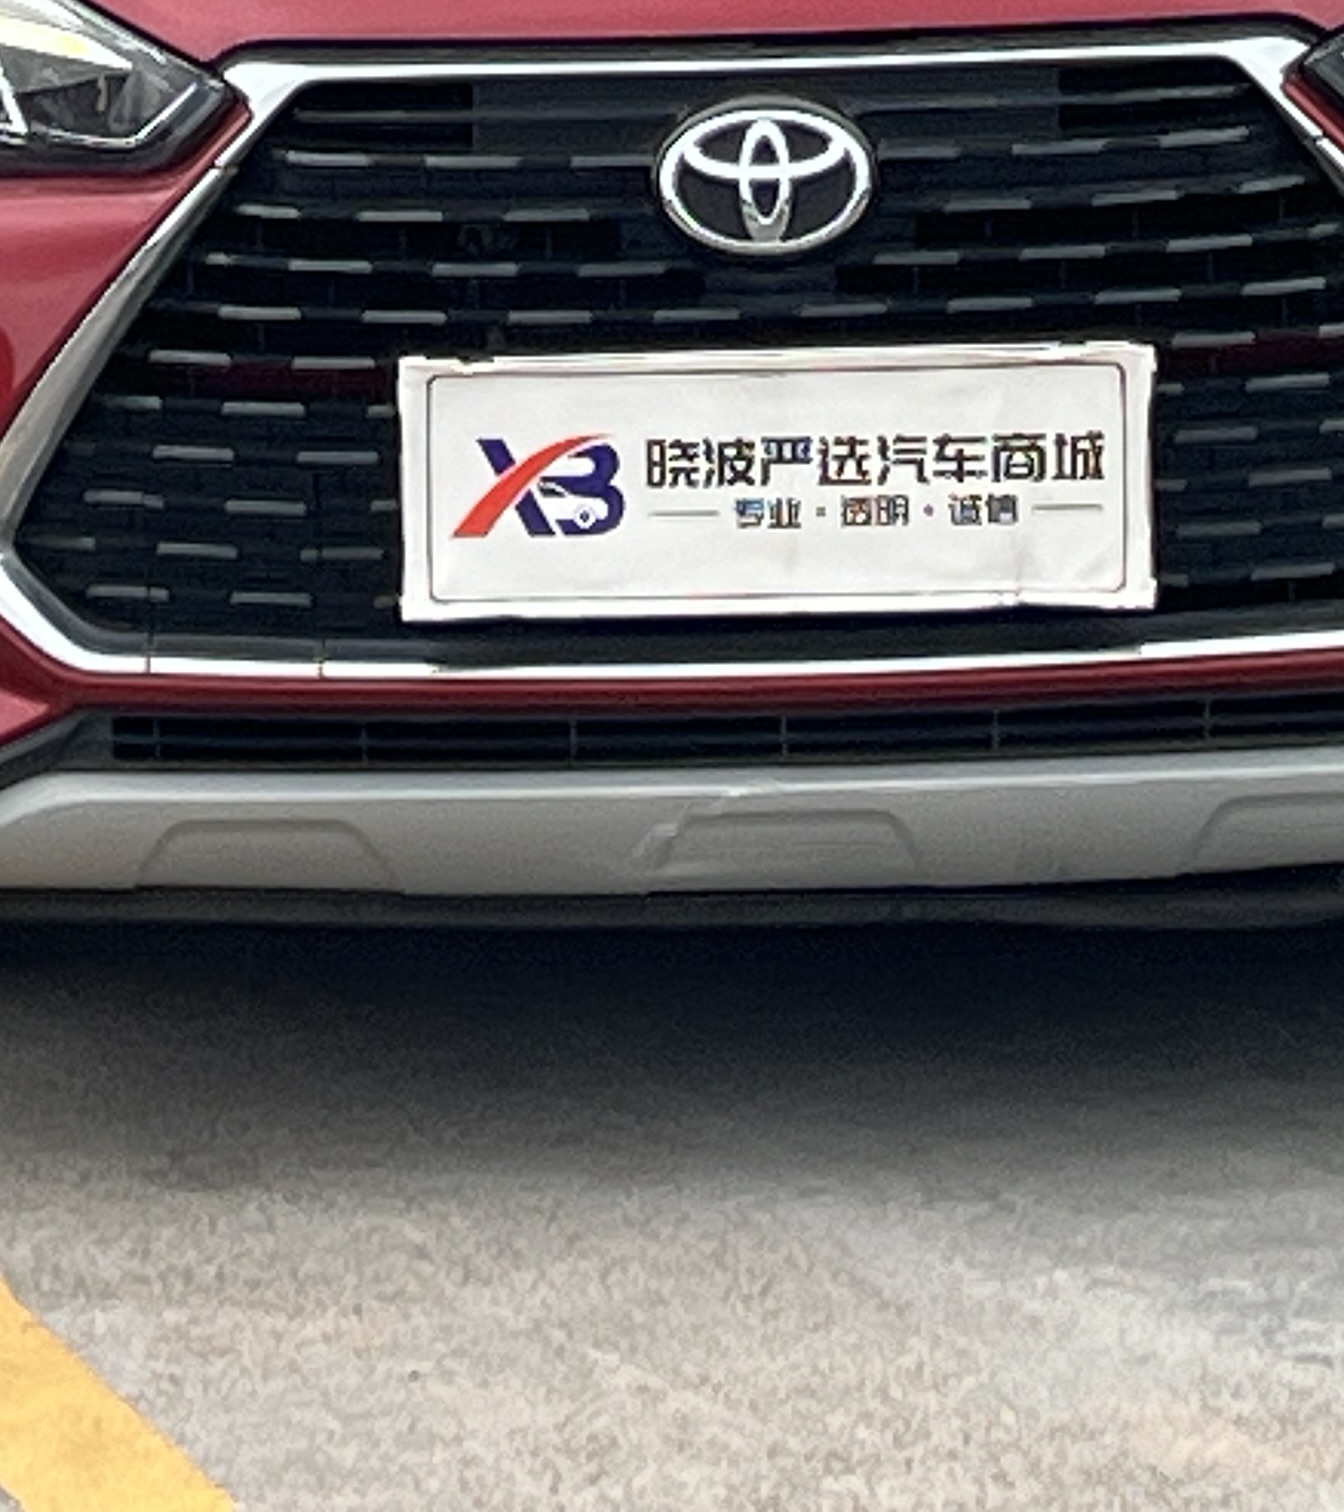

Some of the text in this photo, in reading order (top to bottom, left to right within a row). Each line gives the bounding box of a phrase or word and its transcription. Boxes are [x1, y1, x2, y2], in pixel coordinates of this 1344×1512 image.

[645, 431, 1105, 488] 晓波严选汽车商城
